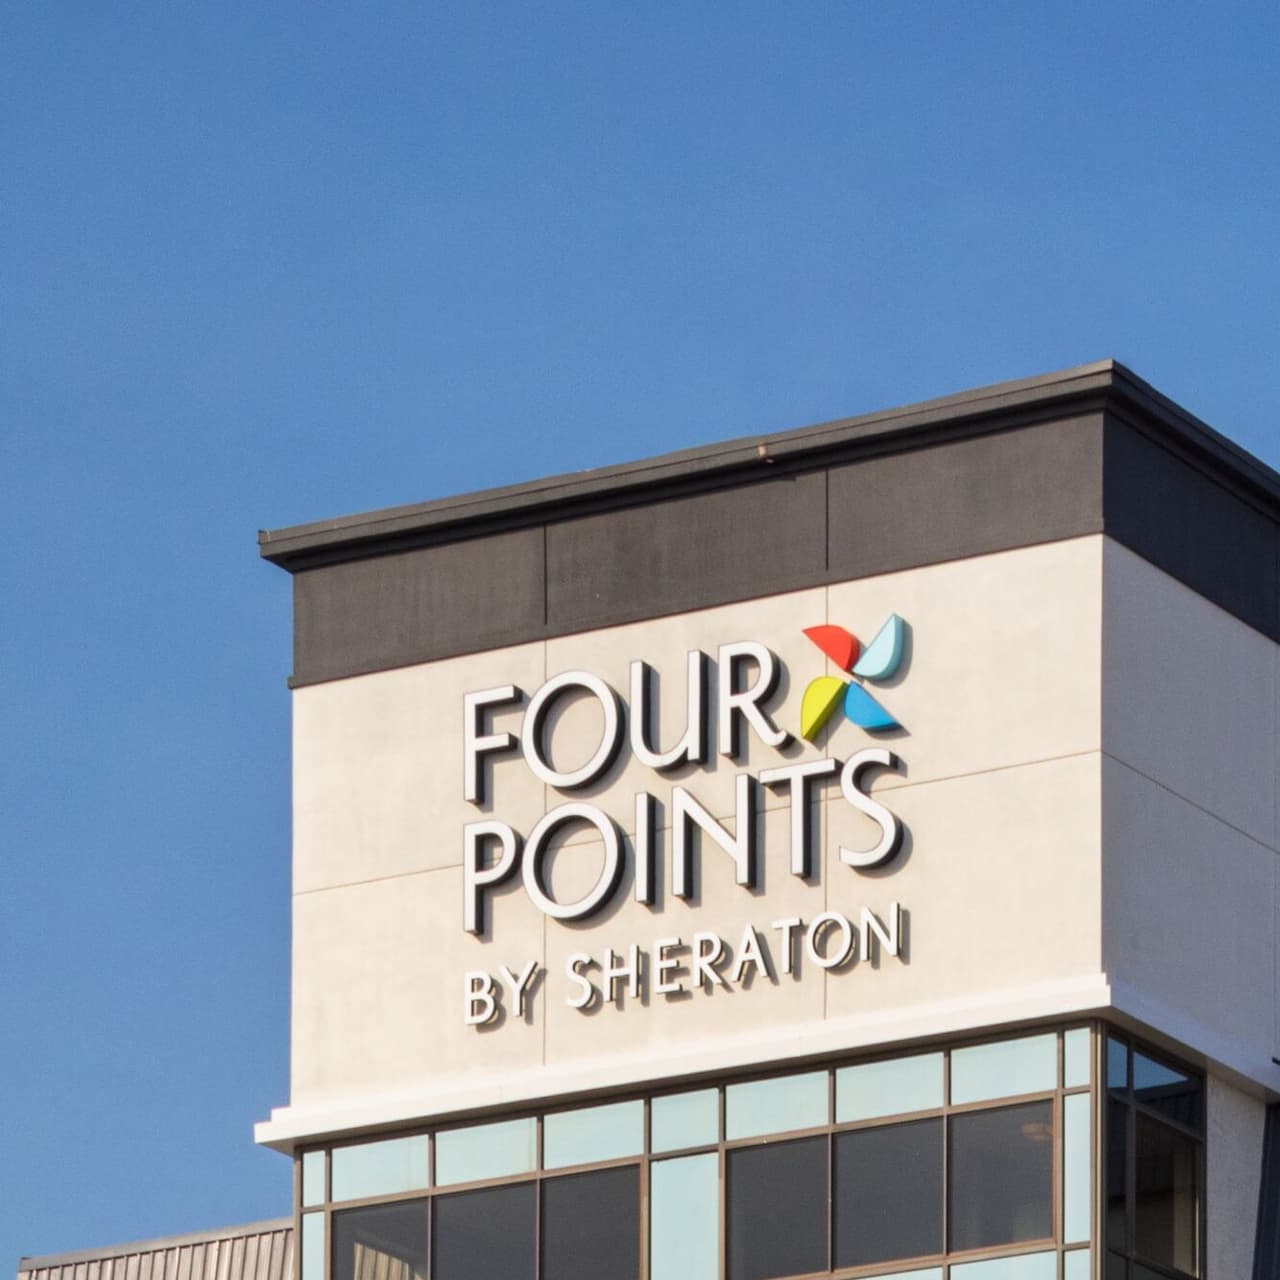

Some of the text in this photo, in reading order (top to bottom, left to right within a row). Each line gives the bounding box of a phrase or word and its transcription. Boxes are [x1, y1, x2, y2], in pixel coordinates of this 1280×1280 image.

[463, 640, 798, 803] FOUR
[463, 746, 908, 937] POINTS
[463, 900, 905, 1027] BY SHERATON
